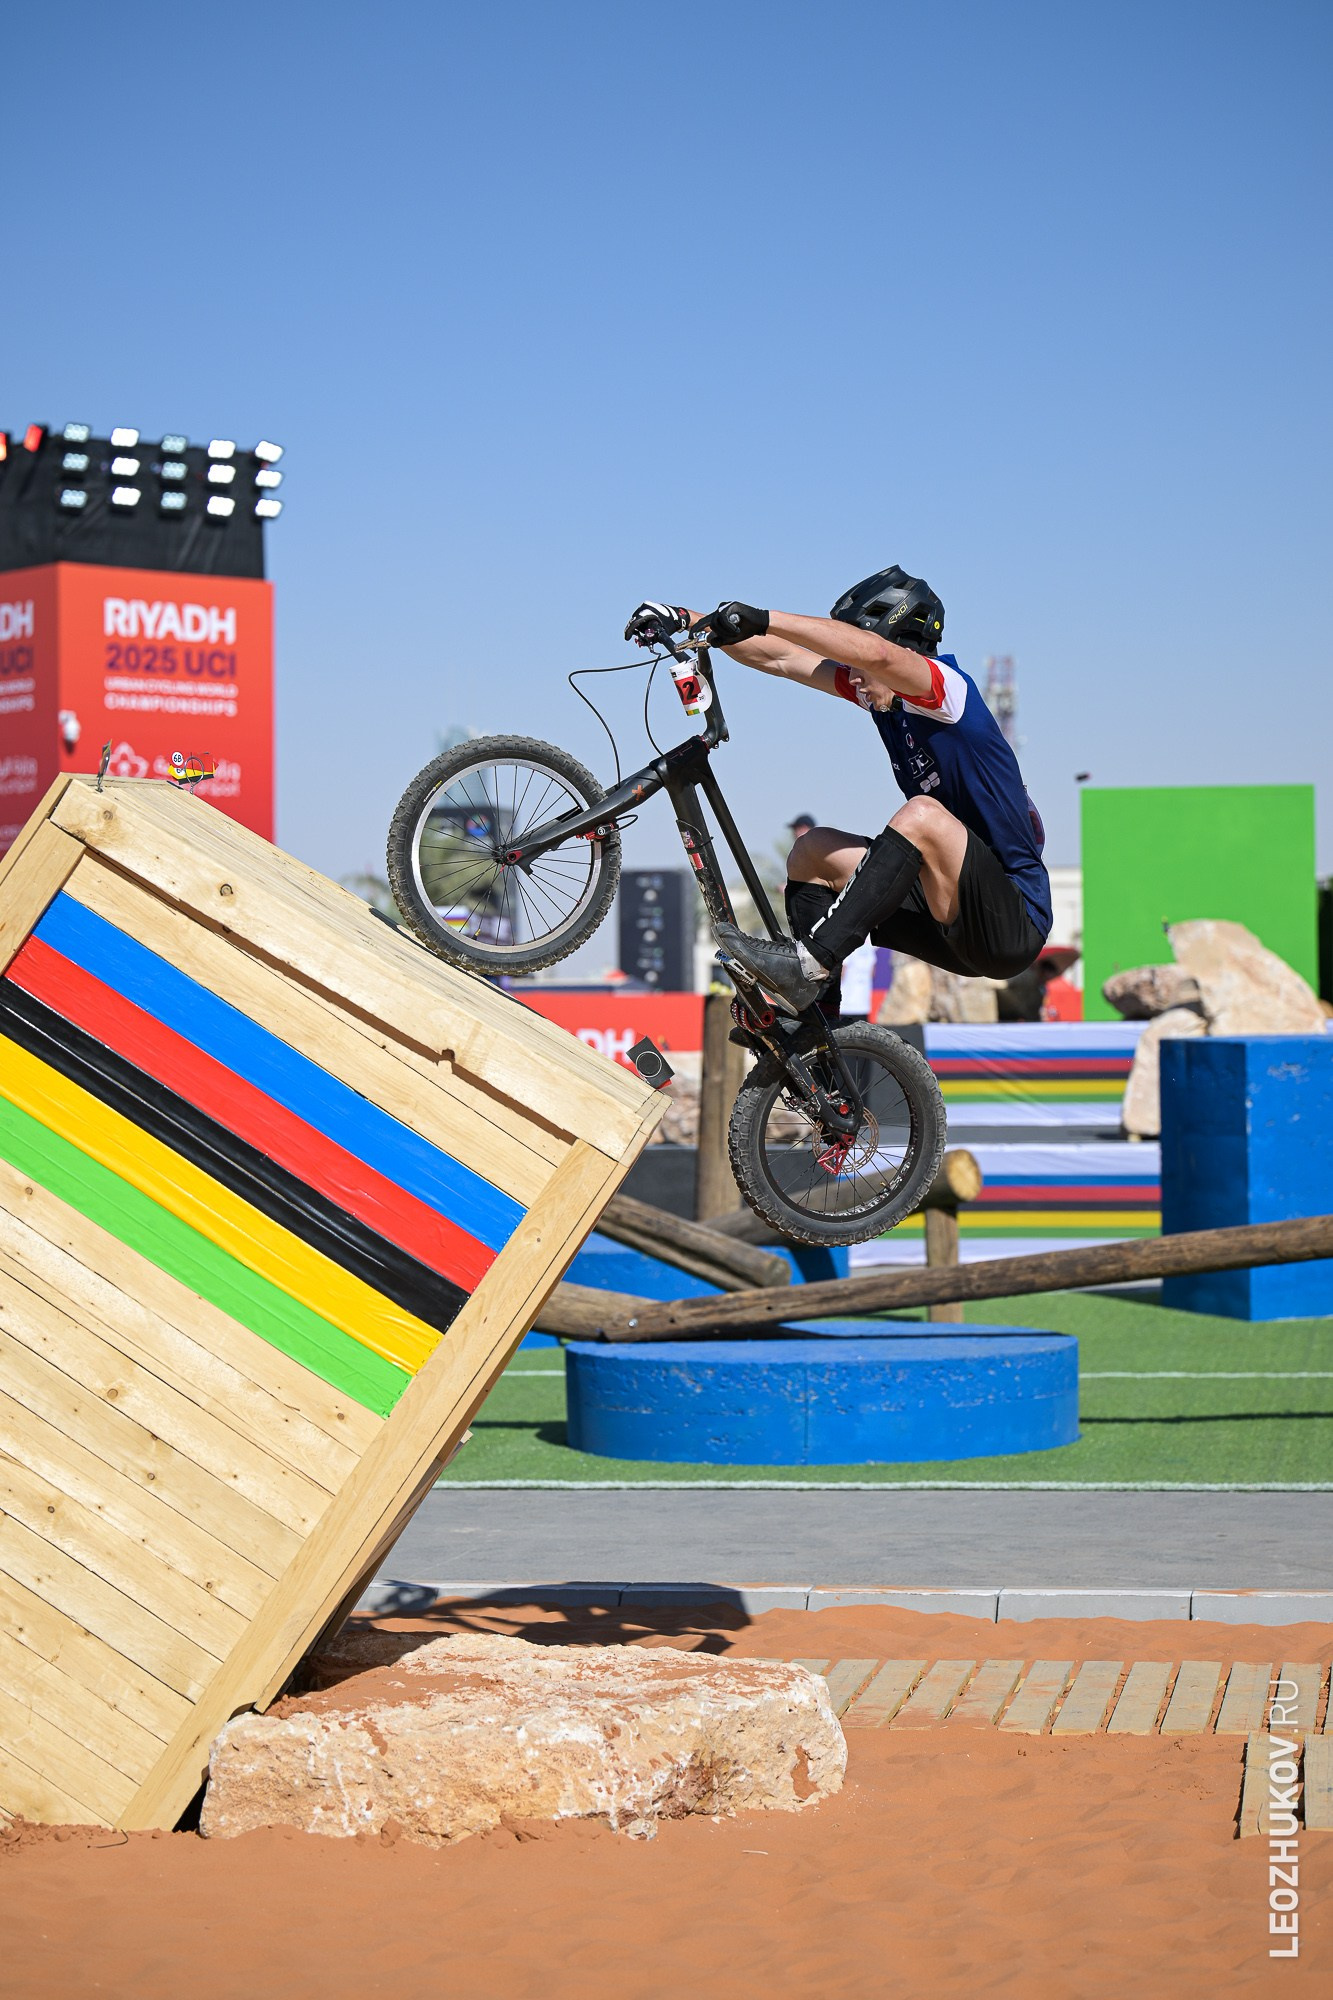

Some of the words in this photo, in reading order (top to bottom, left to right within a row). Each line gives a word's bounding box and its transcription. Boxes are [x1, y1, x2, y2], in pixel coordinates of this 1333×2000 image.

[103, 597, 237, 645] RIYADH
[105, 643, 178, 675] 2025
[184, 650, 237, 678] UCI
[173, 753, 183, 763] 6B
